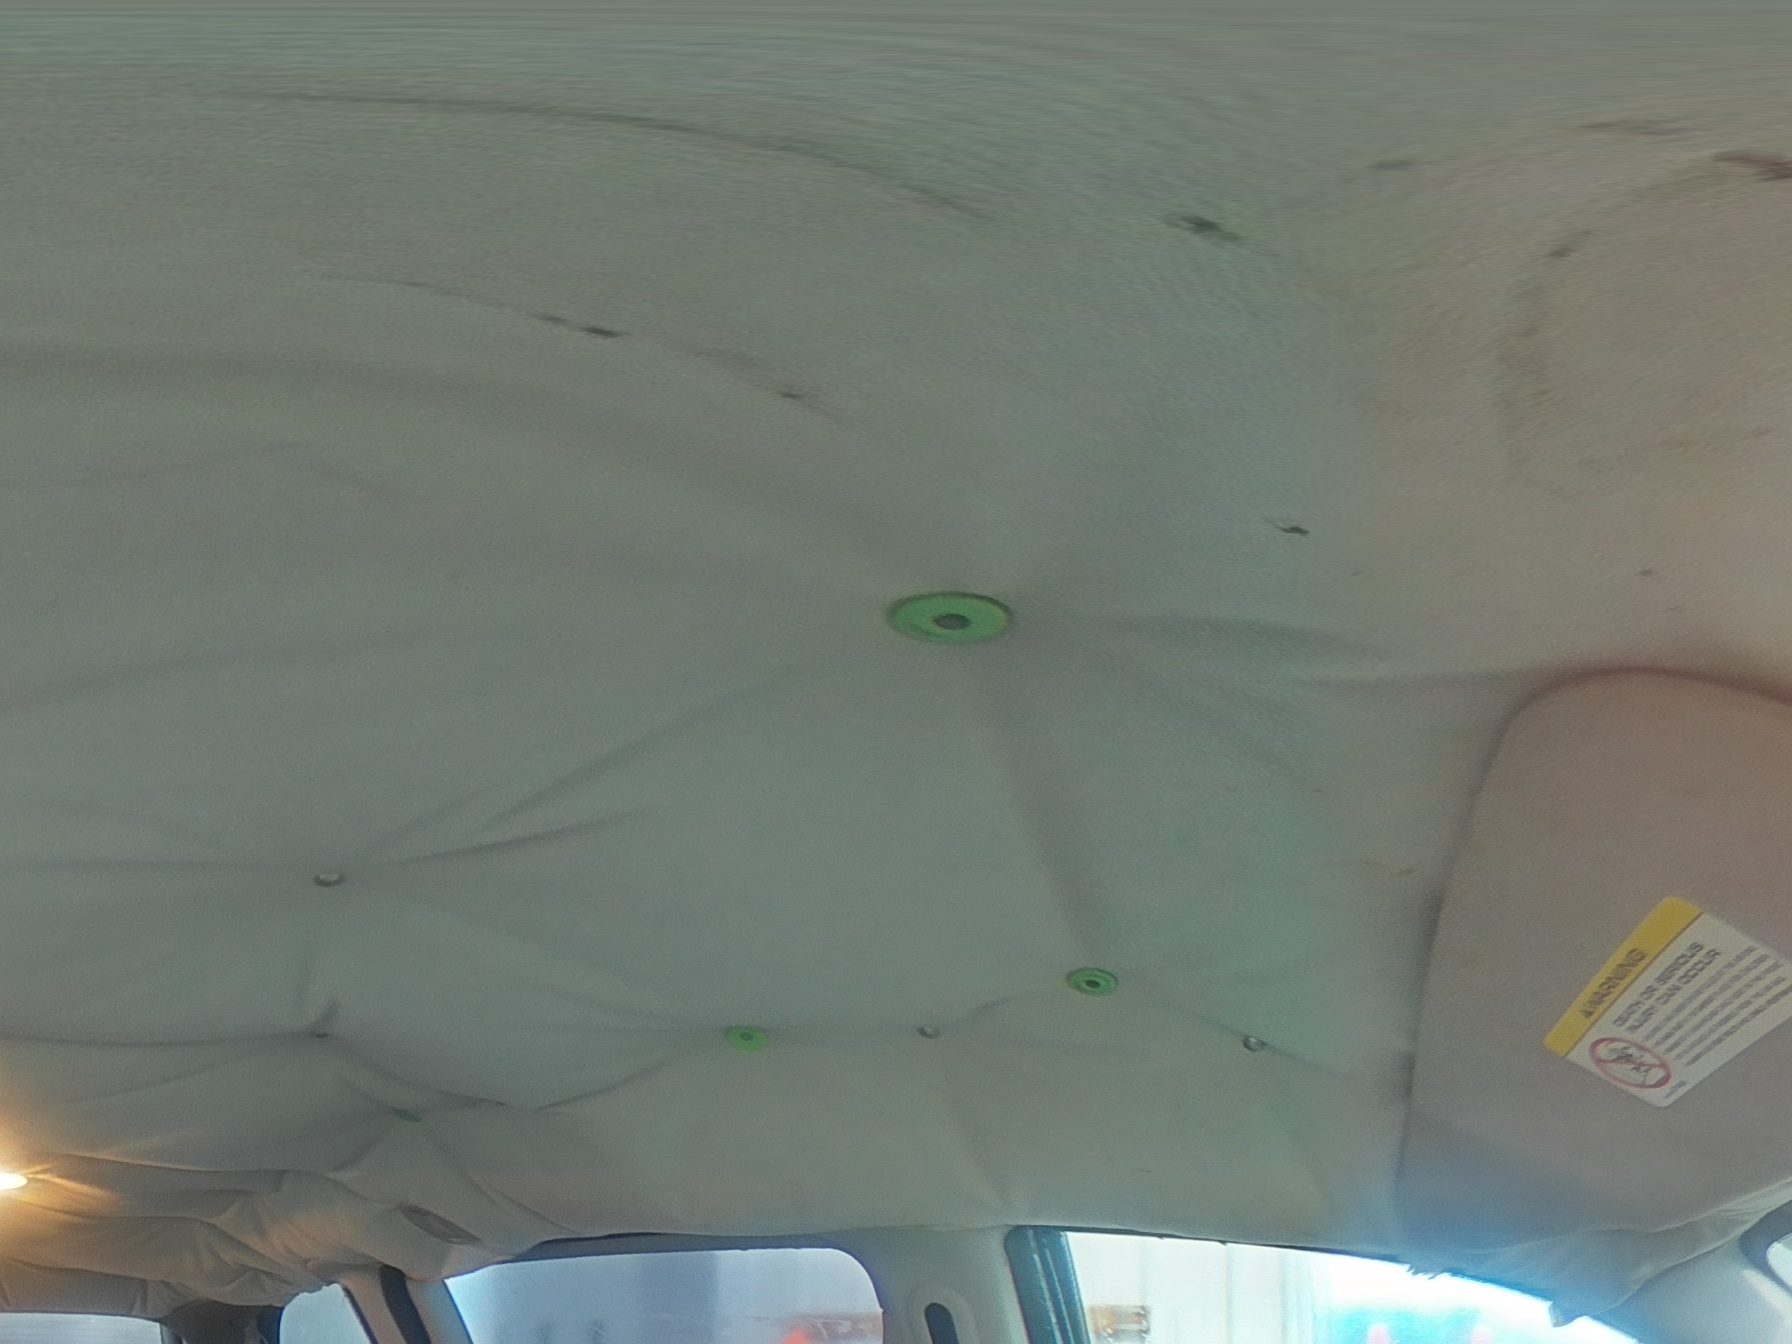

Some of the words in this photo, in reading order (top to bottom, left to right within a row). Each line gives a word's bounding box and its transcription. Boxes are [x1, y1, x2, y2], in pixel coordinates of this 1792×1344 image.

[1590, 947, 1646, 1008] WARNING
[1612, 999, 1641, 1027] DEATH
[1654, 941, 1704, 985] SERIOUS
[1656, 985, 1682, 1006] CAN
[1678, 948, 1721, 985] OCCUR
